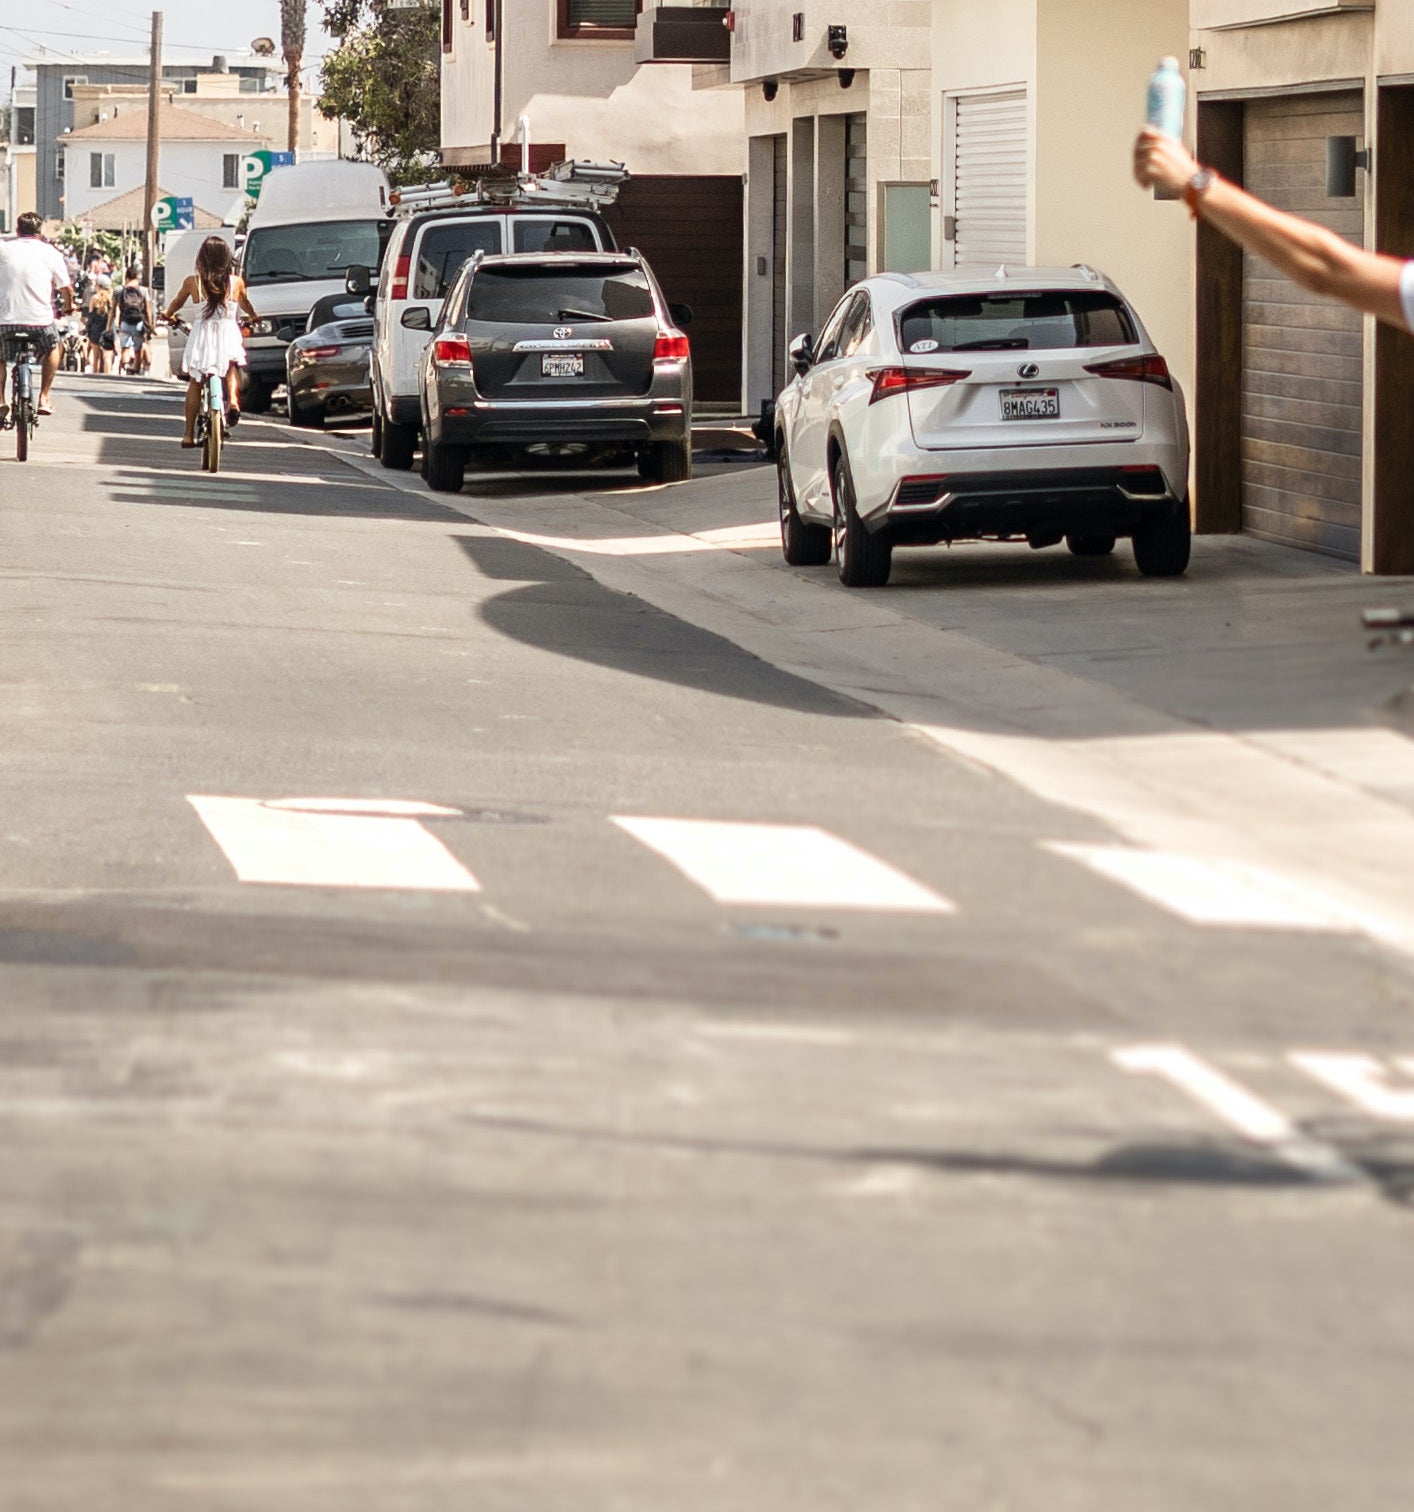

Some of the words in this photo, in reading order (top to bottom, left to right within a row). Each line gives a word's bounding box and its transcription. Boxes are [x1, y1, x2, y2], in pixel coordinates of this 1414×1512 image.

[239, 156, 264, 190] P
[152, 201, 171, 228] P
[1003, 399, 1056, 415] 8MAG435
